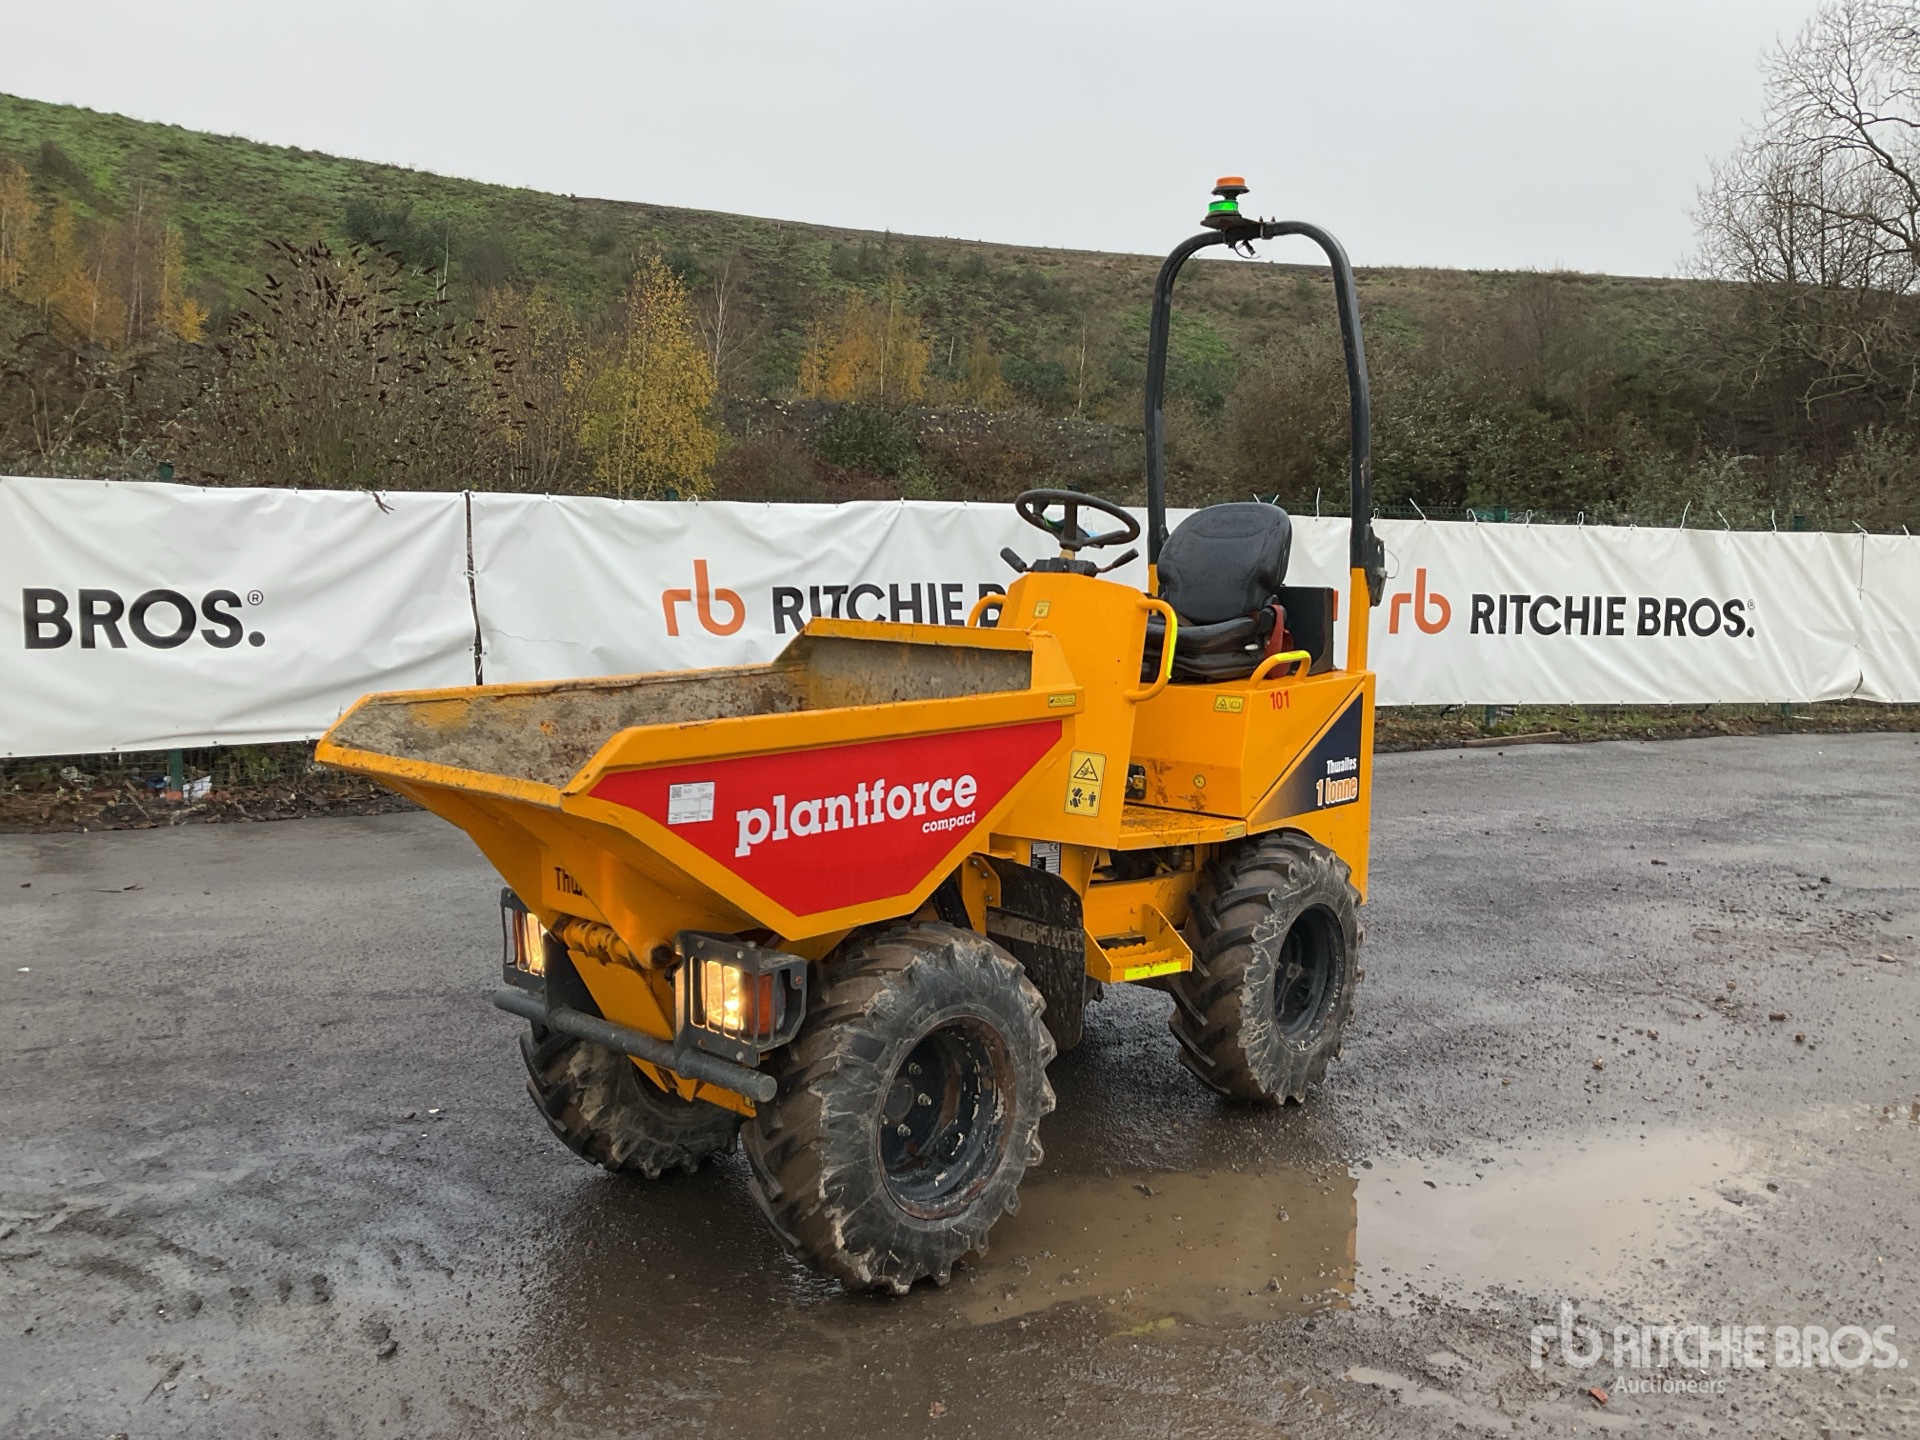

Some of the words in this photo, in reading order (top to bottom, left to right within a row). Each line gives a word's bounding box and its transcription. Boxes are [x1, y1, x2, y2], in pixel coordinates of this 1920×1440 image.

[772, 583, 965, 635] RITCHIE
[1470, 593, 1627, 636] RITCHIE
[1269, 689, 1290, 711] 101
[1315, 778, 1324, 806] 1
[1325, 776, 1358, 805] tonne
[734, 773, 978, 858] plantforce
[921, 809, 977, 834] compact
